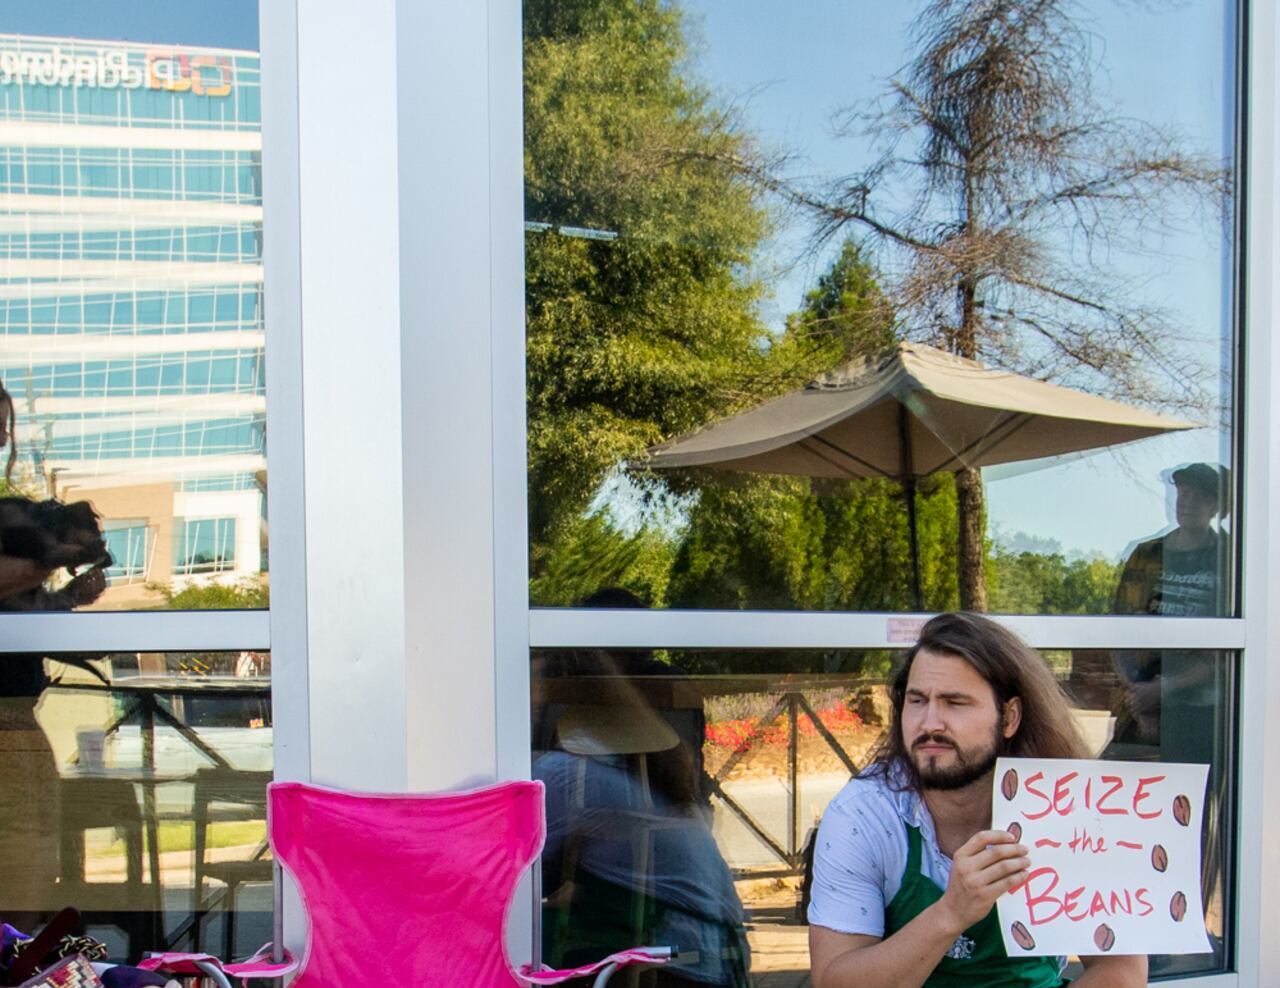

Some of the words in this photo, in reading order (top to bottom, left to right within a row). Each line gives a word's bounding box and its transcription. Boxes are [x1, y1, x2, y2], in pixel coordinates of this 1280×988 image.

[1020, 771, 1167, 821] SEIZE
[1067, 826, 1109, 854] the
[1007, 866, 1155, 927] BEANS
